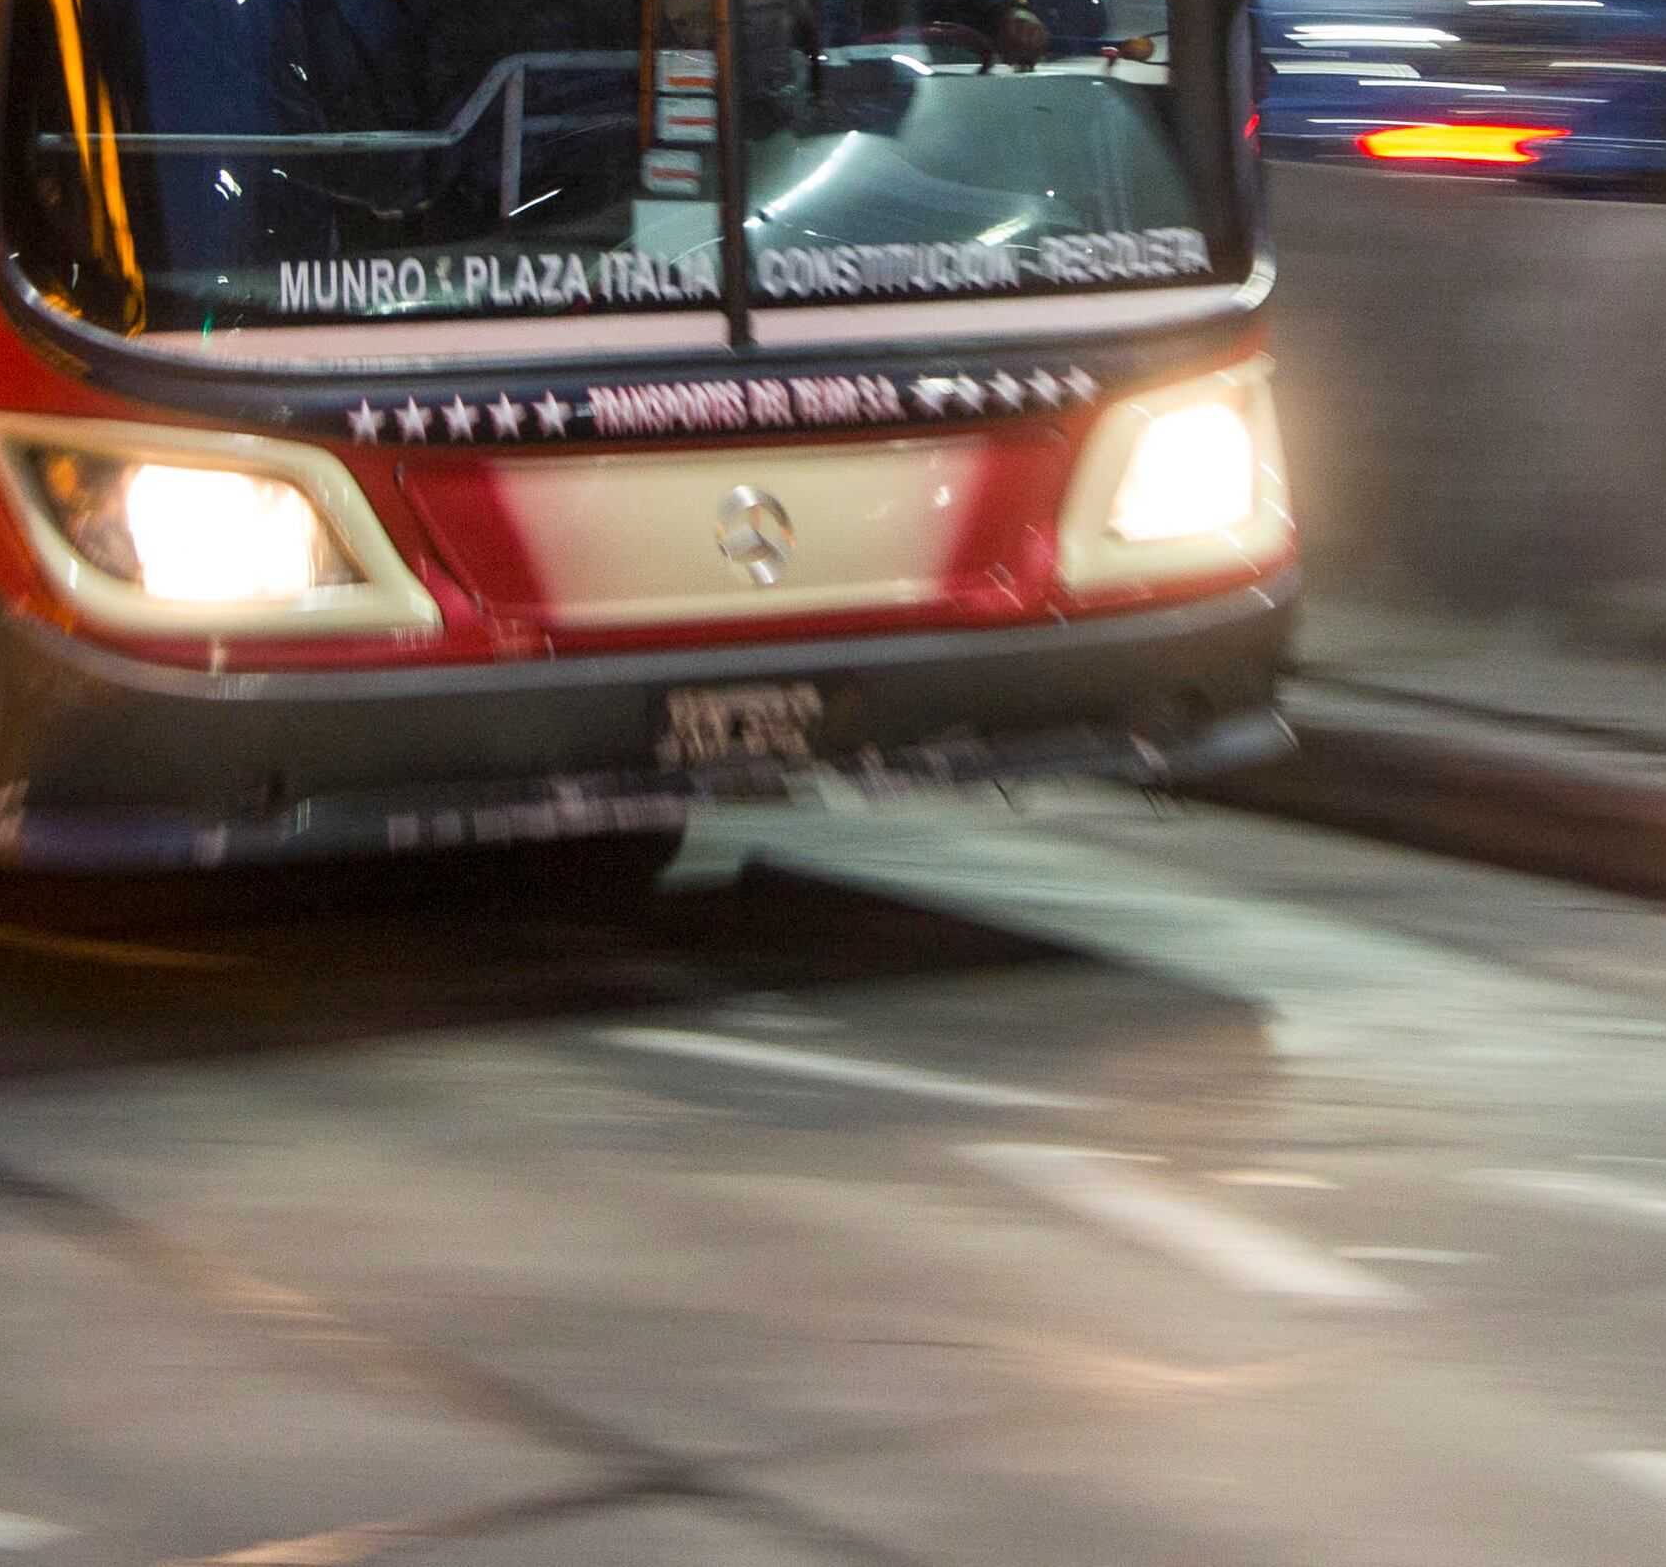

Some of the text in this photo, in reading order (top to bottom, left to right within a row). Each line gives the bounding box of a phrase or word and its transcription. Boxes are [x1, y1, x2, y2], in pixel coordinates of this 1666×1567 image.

[279, 257, 426, 312] MUNRO
[464, 253, 592, 307] PLAZA
[599, 250, 721, 303] ITALIA
